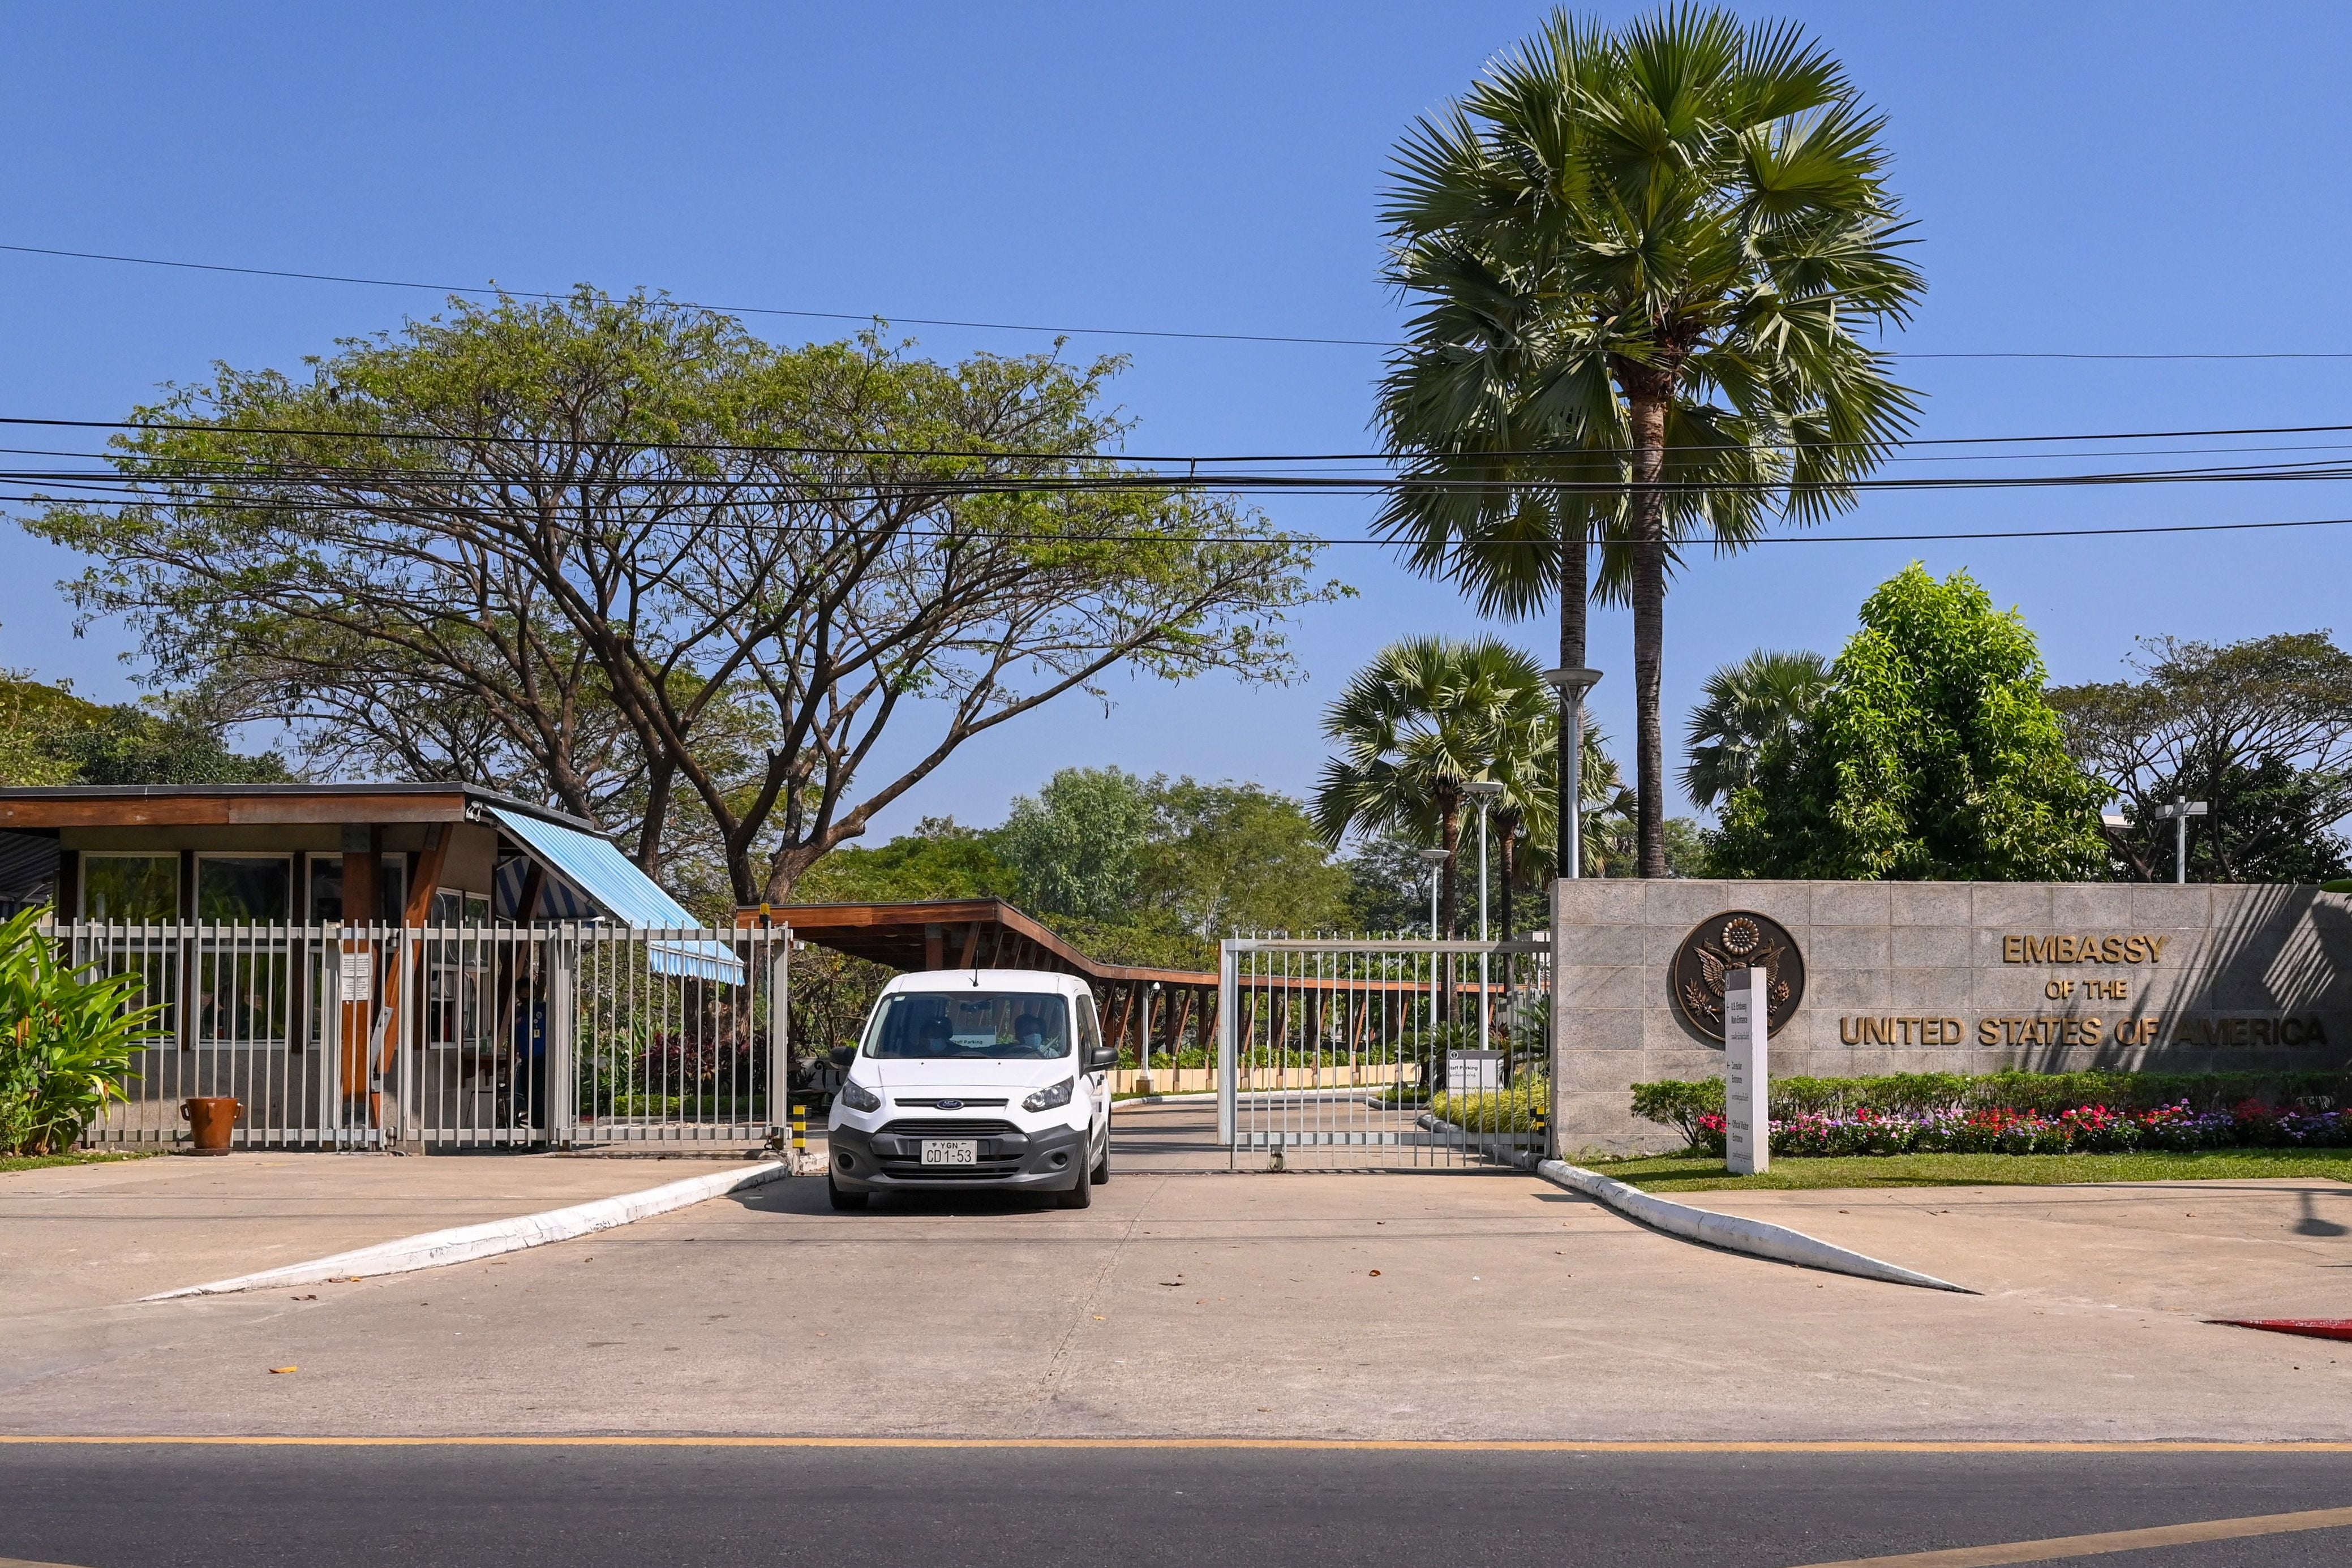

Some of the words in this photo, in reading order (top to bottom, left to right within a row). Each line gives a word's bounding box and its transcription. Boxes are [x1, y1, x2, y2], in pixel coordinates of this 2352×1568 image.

[2003, 934, 2173, 964] EMBASSY
[2045, 980, 2074, 1000] OF
[2083, 980, 2127, 1000] THE
[1840, 1017, 1962, 1046] UNITED
[1978, 1017, 2102, 1046] STATES
[2114, 1017, 2159, 1046] OF
[2173, 1017, 2328, 1047] AMERICA
